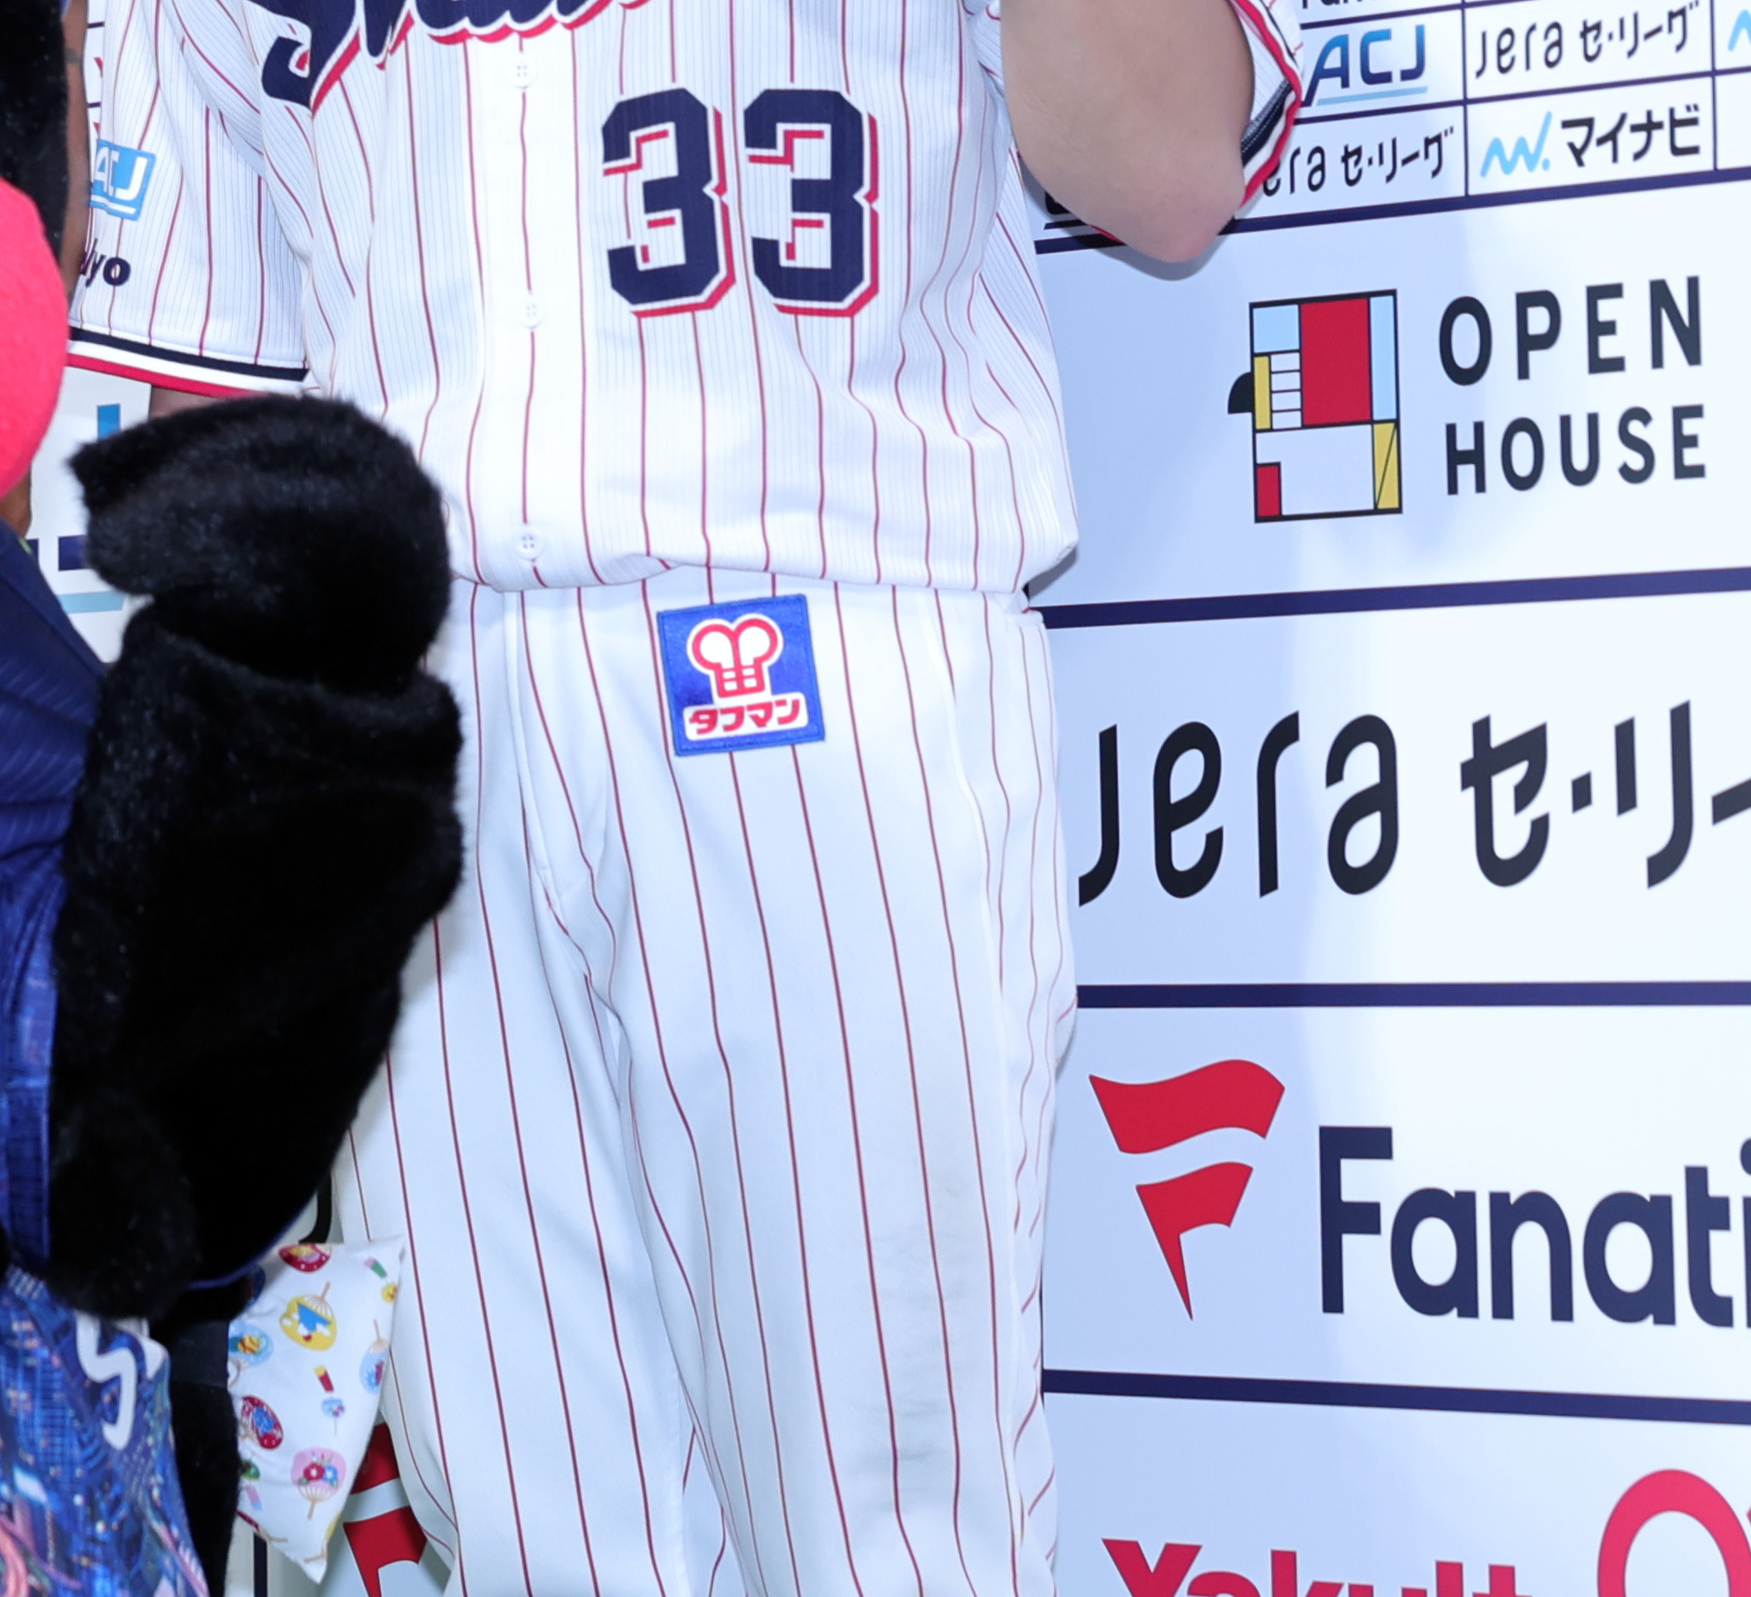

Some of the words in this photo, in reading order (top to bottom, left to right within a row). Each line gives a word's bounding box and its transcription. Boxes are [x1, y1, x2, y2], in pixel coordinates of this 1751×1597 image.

[1305, 25, 1425, 108] ACJ
[1561, 104, 1700, 167] マイナビ
[601, 87, 879, 318] 33
[1438, 275, 1704, 387] OPEN
[1445, 404, 1707, 496] HOUSE
[689, 699, 800, 735] タフマン
